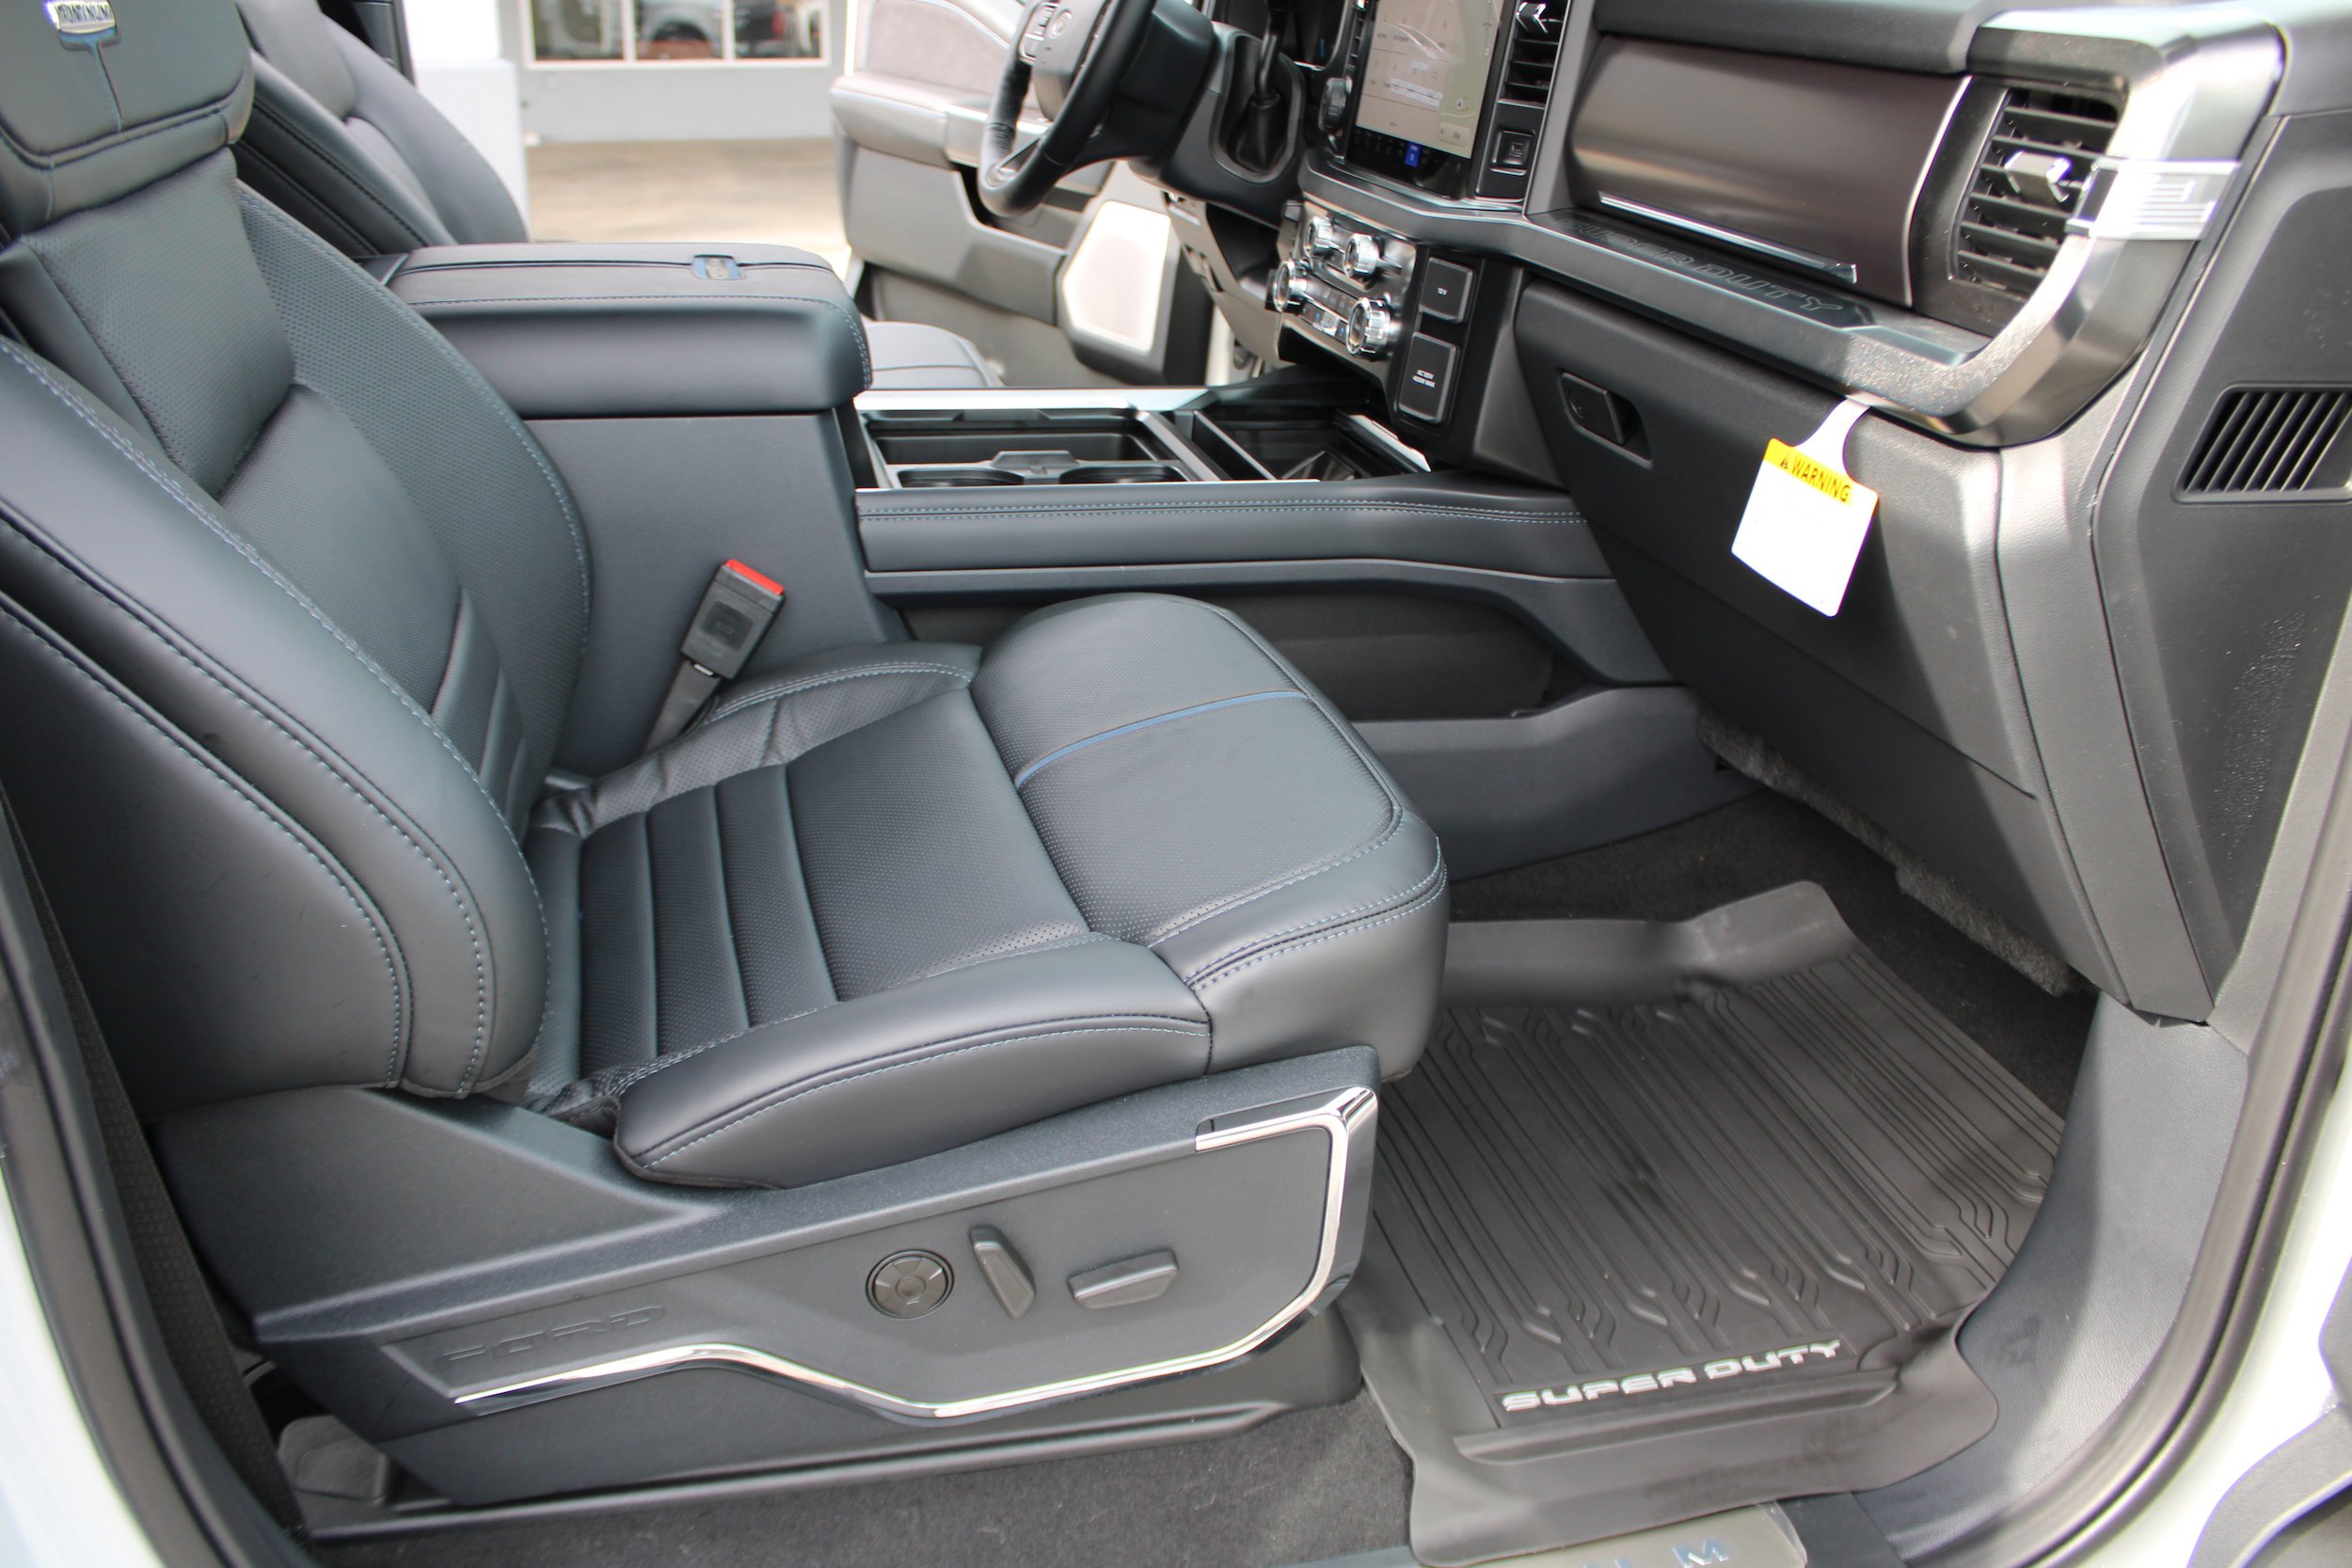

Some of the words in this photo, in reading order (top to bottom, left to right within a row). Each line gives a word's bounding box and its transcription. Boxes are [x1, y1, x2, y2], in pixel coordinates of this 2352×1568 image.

[1560, 217, 1695, 266] SUPER
[1691, 262, 1844, 312] DUTY
[1791, 451, 1851, 502] WARNING
[436, 1304, 666, 1369] FORD
[1502, 1366, 1697, 1412] SUPER
[1703, 1338, 1841, 1380] DUTY
